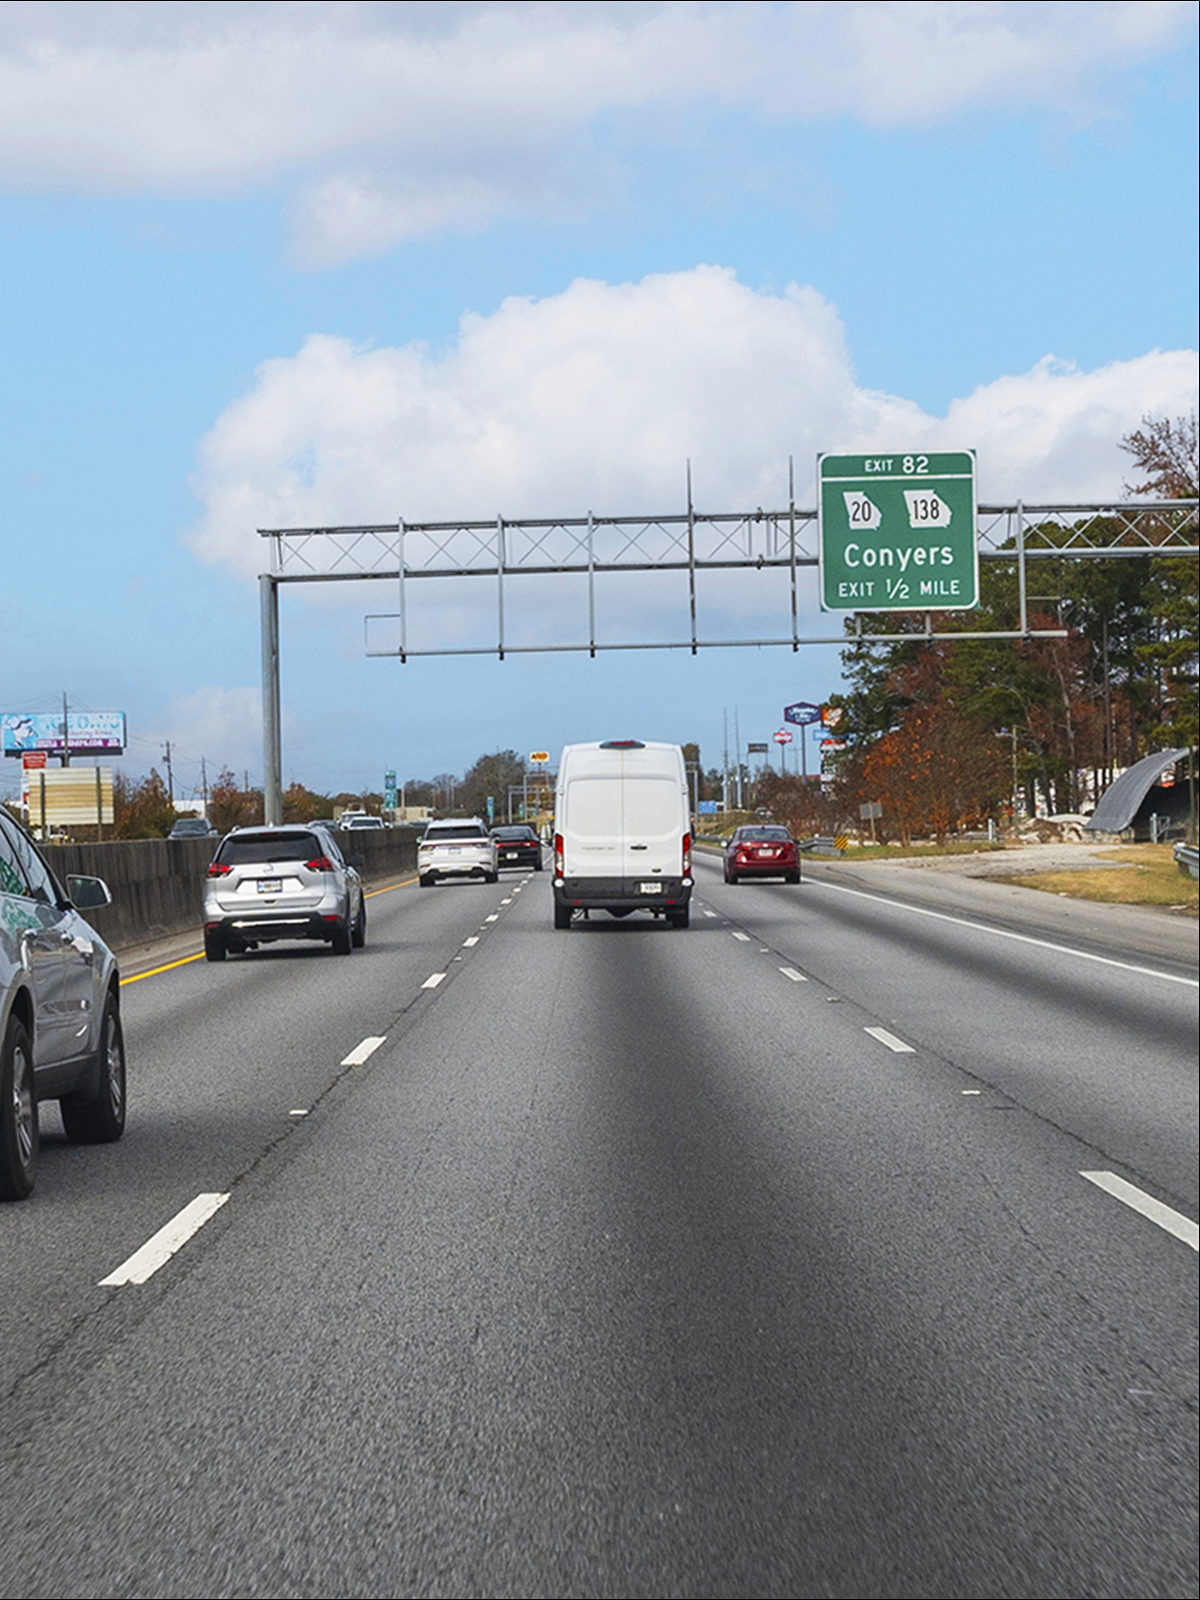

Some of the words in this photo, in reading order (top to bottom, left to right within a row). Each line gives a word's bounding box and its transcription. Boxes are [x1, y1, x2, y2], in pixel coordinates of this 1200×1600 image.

[864, 459, 894, 473] EXIT
[902, 456, 929, 473] 82
[851, 501, 872, 522] 20
[913, 499, 940, 520] 138
[844, 543, 954, 572] Conyers
[838, 582, 875, 598] EXIT
[920, 580, 961, 596] MILE
